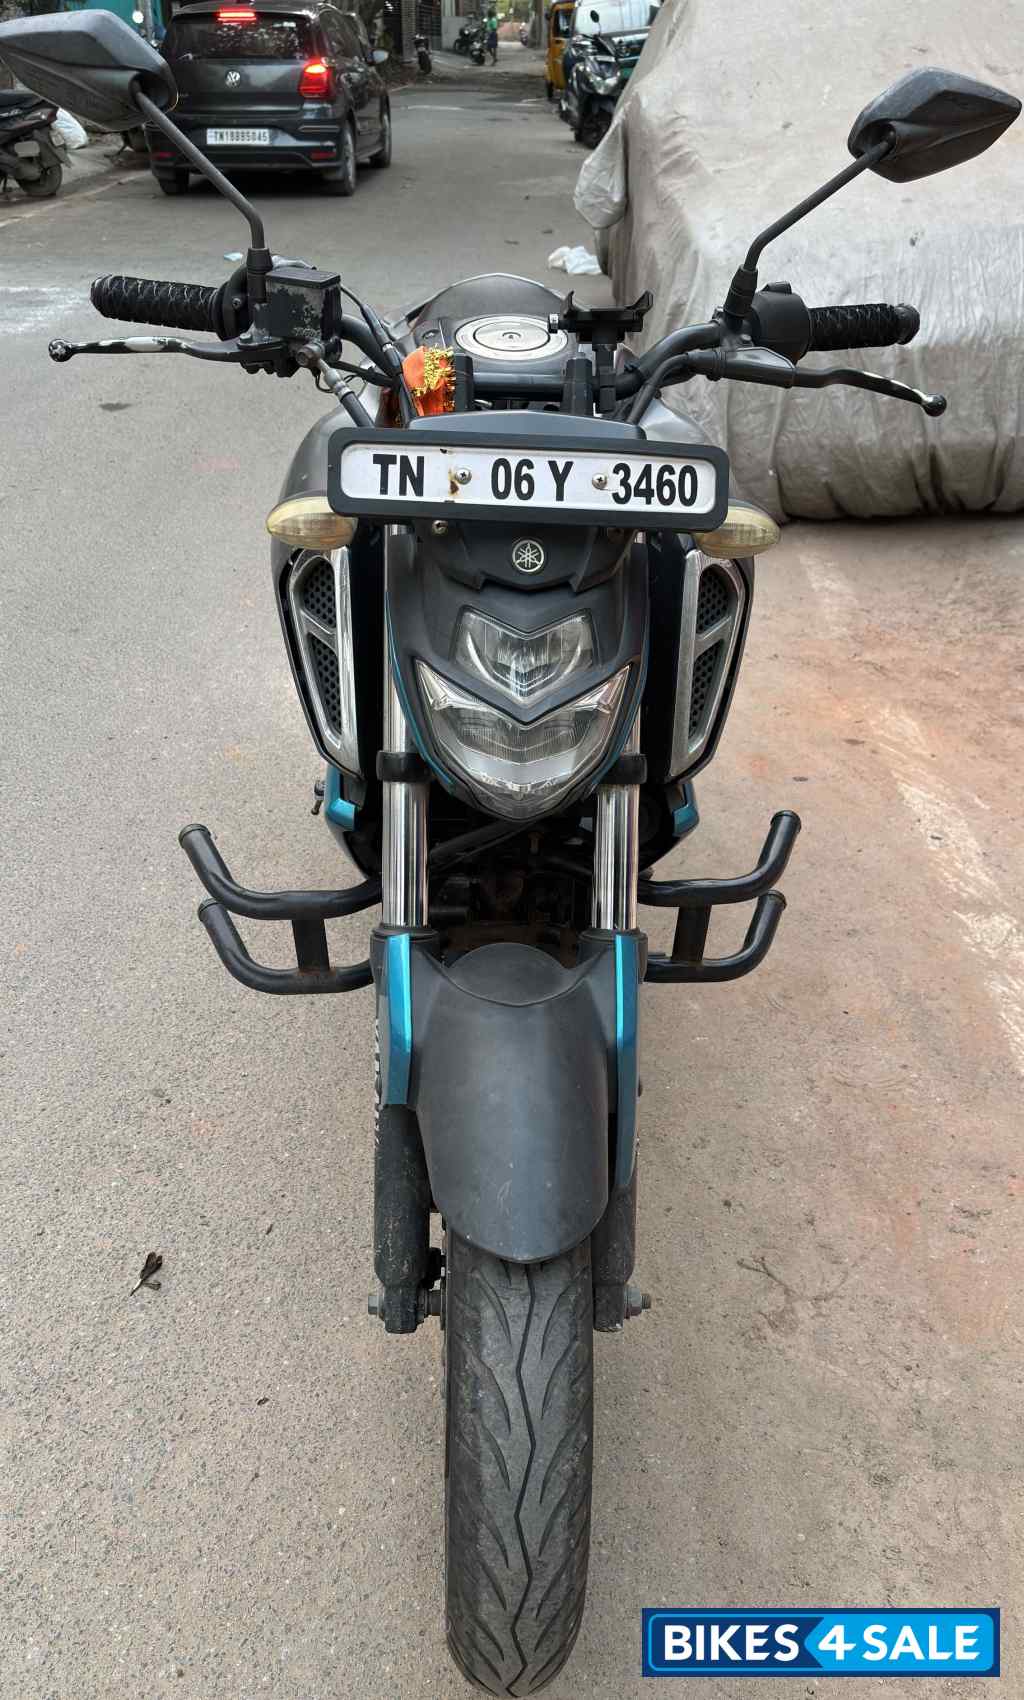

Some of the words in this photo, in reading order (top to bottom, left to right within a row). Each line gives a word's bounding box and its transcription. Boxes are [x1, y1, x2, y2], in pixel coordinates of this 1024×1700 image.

[373, 453, 424, 497] TN
[491, 458, 535, 501] 06
[547, 460, 574, 501] Y
[611, 463, 698, 507] 3460
